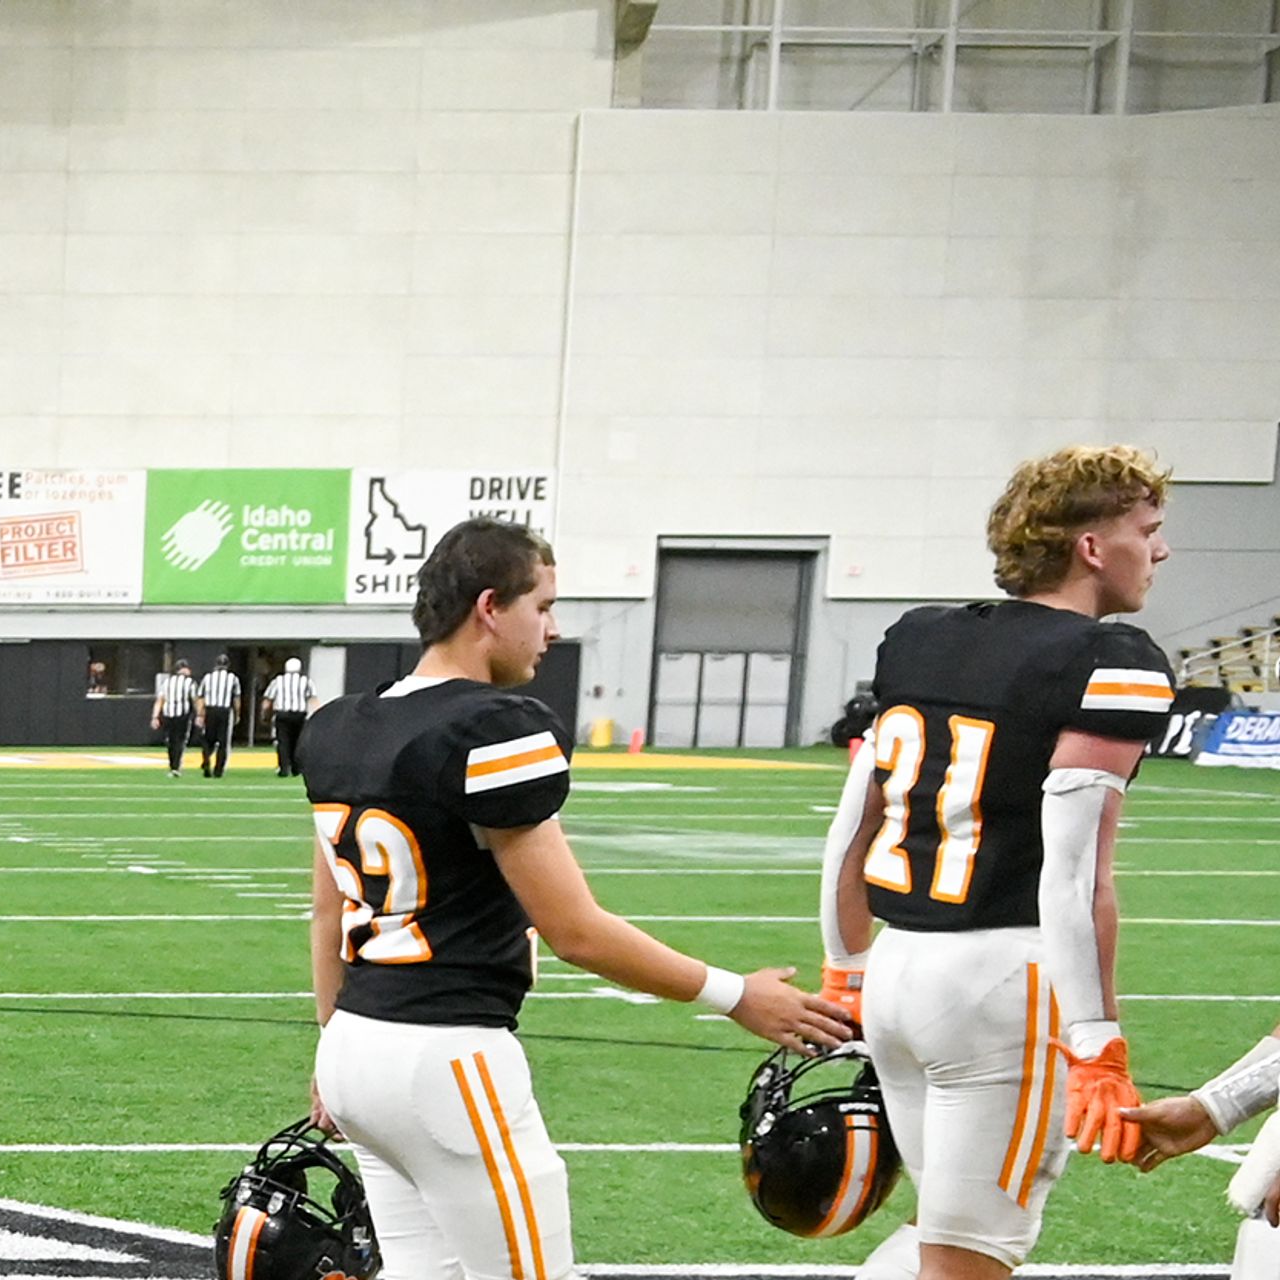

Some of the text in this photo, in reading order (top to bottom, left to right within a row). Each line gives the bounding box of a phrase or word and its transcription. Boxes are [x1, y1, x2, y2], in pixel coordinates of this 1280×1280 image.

[469, 476, 548, 501] DRIVE
[242, 504, 312, 528] Idaho
[0, 520, 76, 541] PROJECT
[241, 528, 335, 552] Central
[0, 539, 77, 564] FILTER
[863, 703, 996, 905] 21
